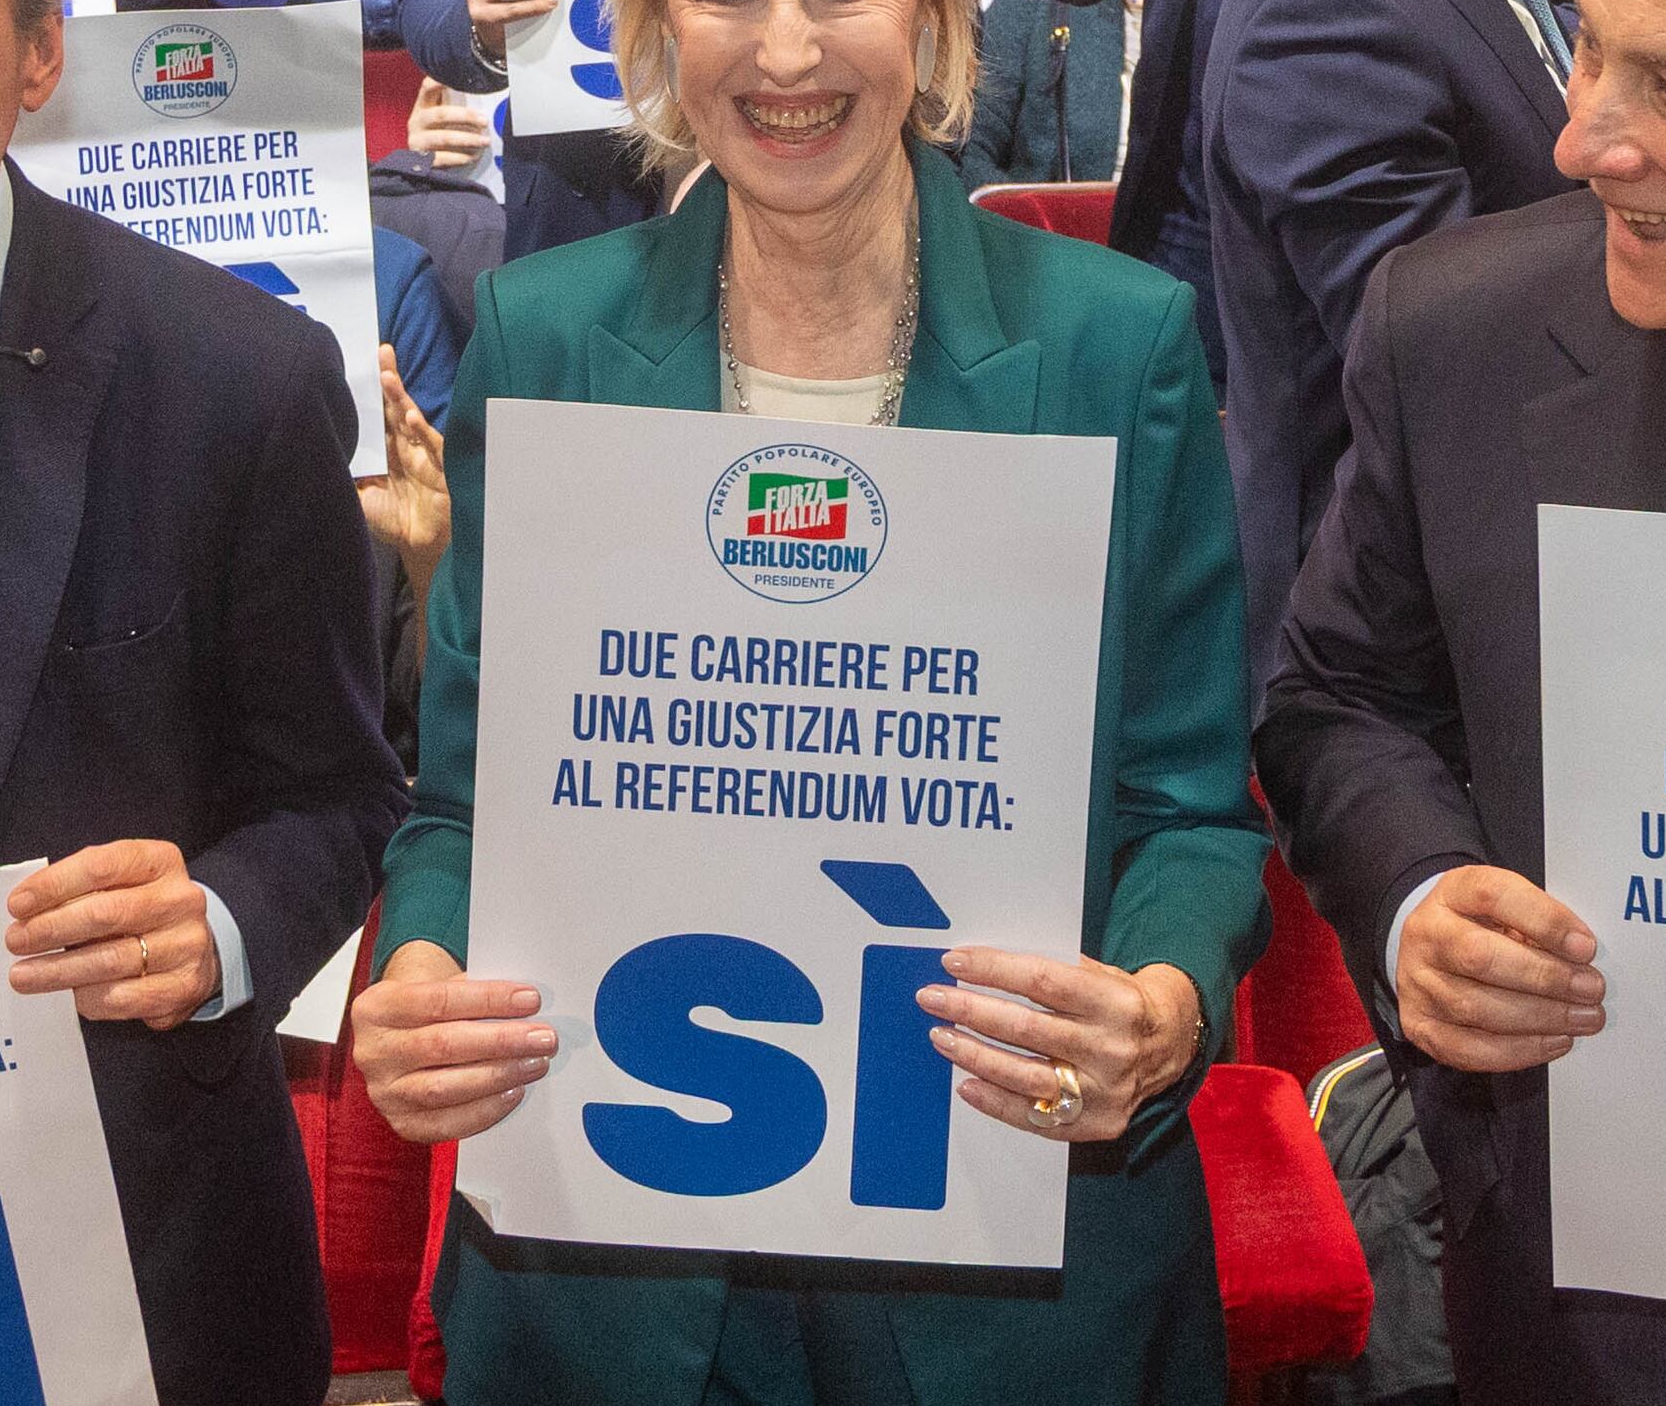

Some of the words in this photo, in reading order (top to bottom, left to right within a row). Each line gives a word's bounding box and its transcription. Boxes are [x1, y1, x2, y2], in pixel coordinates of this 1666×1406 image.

[165, 58, 205, 80] ITALIA
[166, 44, 202, 66] FORZA
[144, 81, 228, 101] BERLUSCONI
[79, 144, 124, 175] DUE
[132, 134, 246, 170] CARRIERE
[254, 130, 297, 160] PER
[123, 174, 235, 210] GIUSTIZIA
[243, 168, 314, 200] FORTE
[262, 207, 327, 238] VOTA:
[712, 462, 750, 516] PARTITO
[755, 447, 839, 467] POPOLARE
[843, 465, 882, 526] EUROPEO
[765, 480, 828, 511] FORZA
[763, 503, 831, 534] ITALIA
[723, 538, 868, 573] BERLUSCONI
[754, 574, 835, 589] PRESIDENTE
[600, 630, 678, 679] DUE
[691, 635, 890, 690] CARRIERE
[903, 646, 978, 695] PER
[573, 694, 654, 744] UNA
[668, 699, 860, 755] GIUSTIZIA
[875, 710, 1000, 762] FORTE
[553, 759, 602, 807] AL
[615, 762, 887, 823] REFERENDUM
[902, 777, 1014, 830] VOTA:
